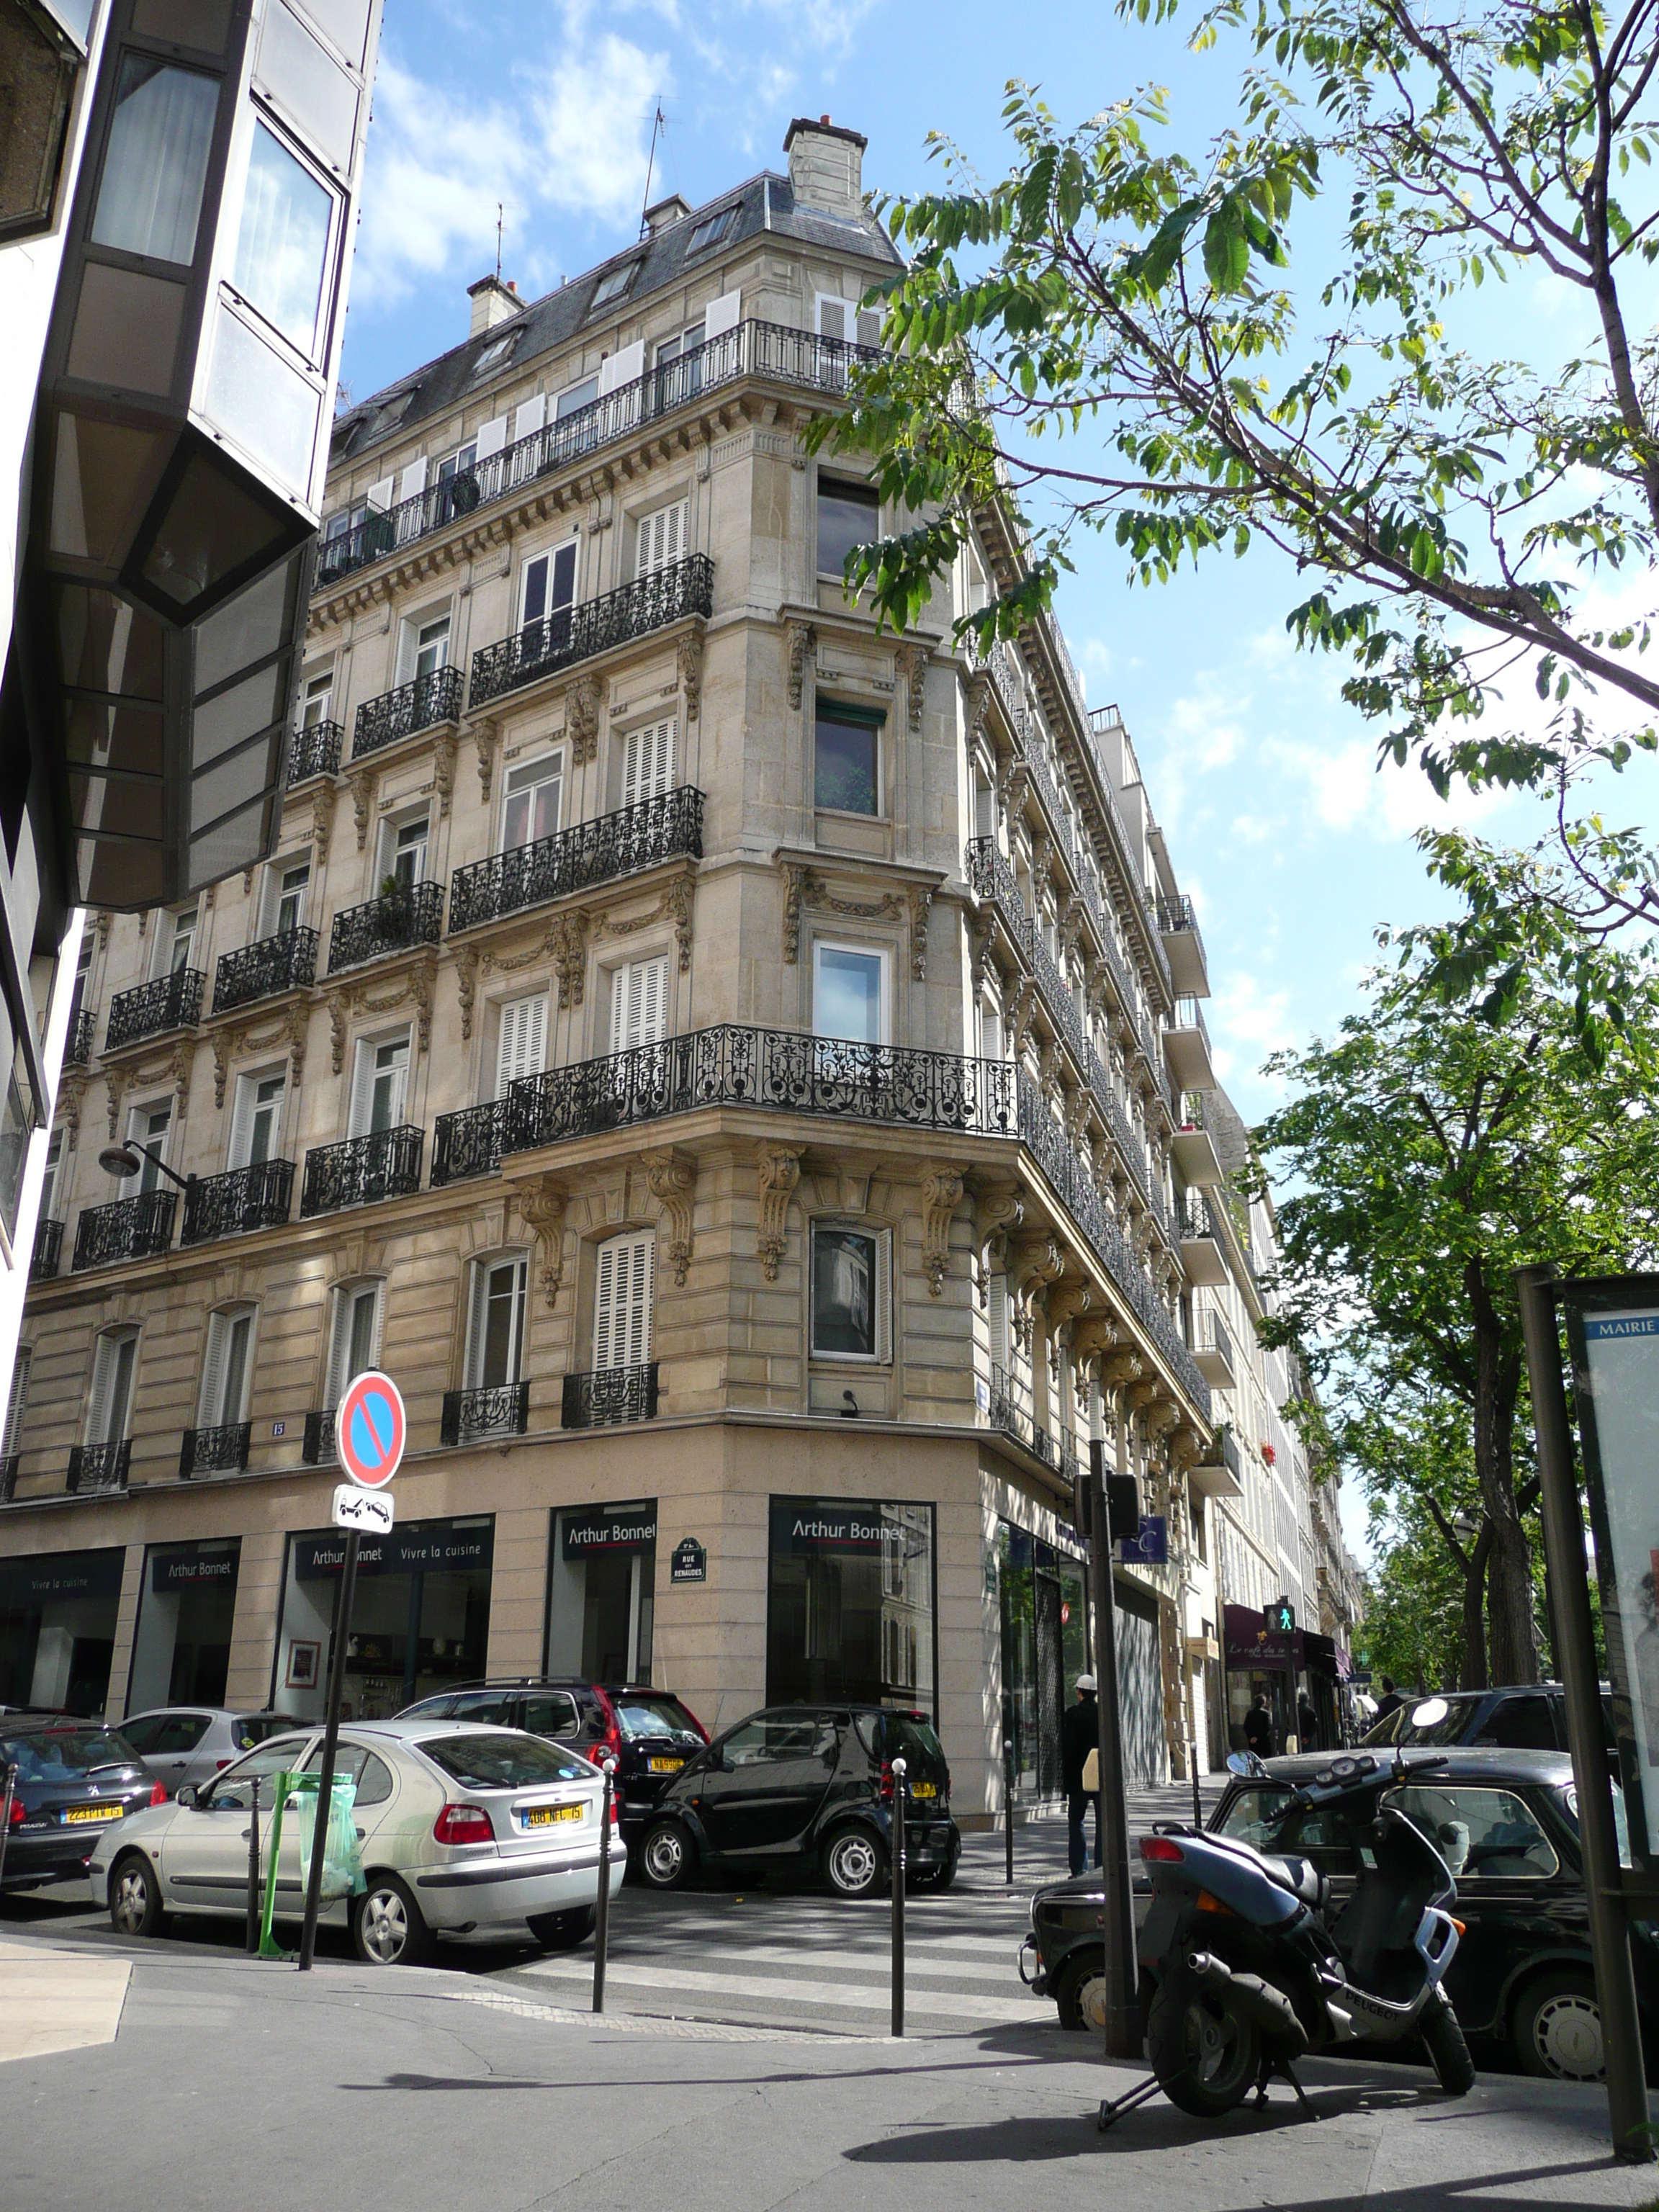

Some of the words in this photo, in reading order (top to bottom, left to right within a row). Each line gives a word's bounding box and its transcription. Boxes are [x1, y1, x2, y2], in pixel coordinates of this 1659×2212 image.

[1599, 1321, 1655, 1335] MAIRIE
[274, 1424, 283, 1435] 15
[569, 1527, 609, 1545] Arthur
[792, 1519, 845, 1538] Arthur
[850, 1522, 906, 1540] Bonnet
[313, 1550, 345, 1565] Arthur
[352, 1547, 382, 1562] nnet
[401, 1548, 427, 1560] Vivre
[431, 1545, 441, 1557] la
[445, 1544, 481, 1557] cuisine
[168, 1563, 197, 1578] Arthur
[199, 1562, 231, 1575] Bonnet
[32, 1580, 50, 1590] Vivre
[53, 1578, 60, 1588] la
[63, 1577, 89, 1588] cuisine
[69, 1808, 86, 1821] 223
[109, 1805, 120, 1816] 75
[529, 1809, 546, 1824] 408
[549, 1807, 565, 1822] NFC
[570, 1805, 580, 1820] 75
[1345, 1990, 1401, 2022] PEUGEOT
